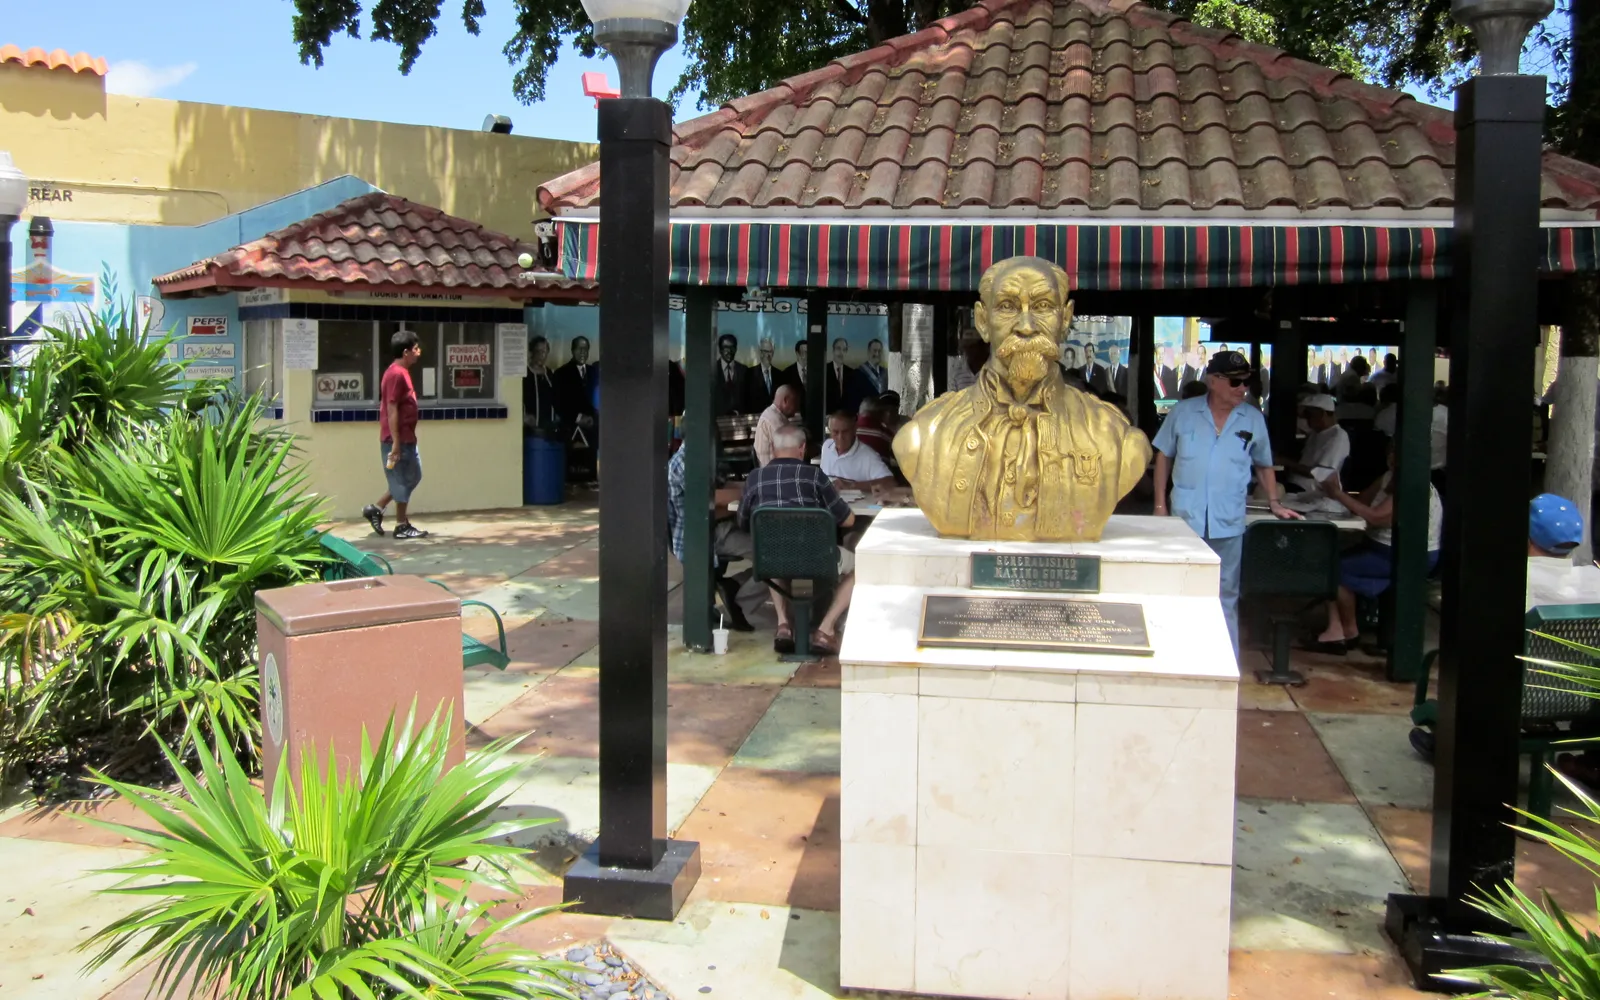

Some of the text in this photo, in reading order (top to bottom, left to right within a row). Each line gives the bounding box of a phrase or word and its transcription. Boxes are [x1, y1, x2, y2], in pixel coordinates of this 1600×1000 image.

[31, 188, 73, 202] REAR
[193, 317, 227, 325] PEPSI
[450, 354, 487, 363] FUMAR
[336, 378, 360, 390] NO
[996, 555, 1077, 569] GENERALISIMO
[994, 567, 1079, 581] MAXIMO GOMEZ
